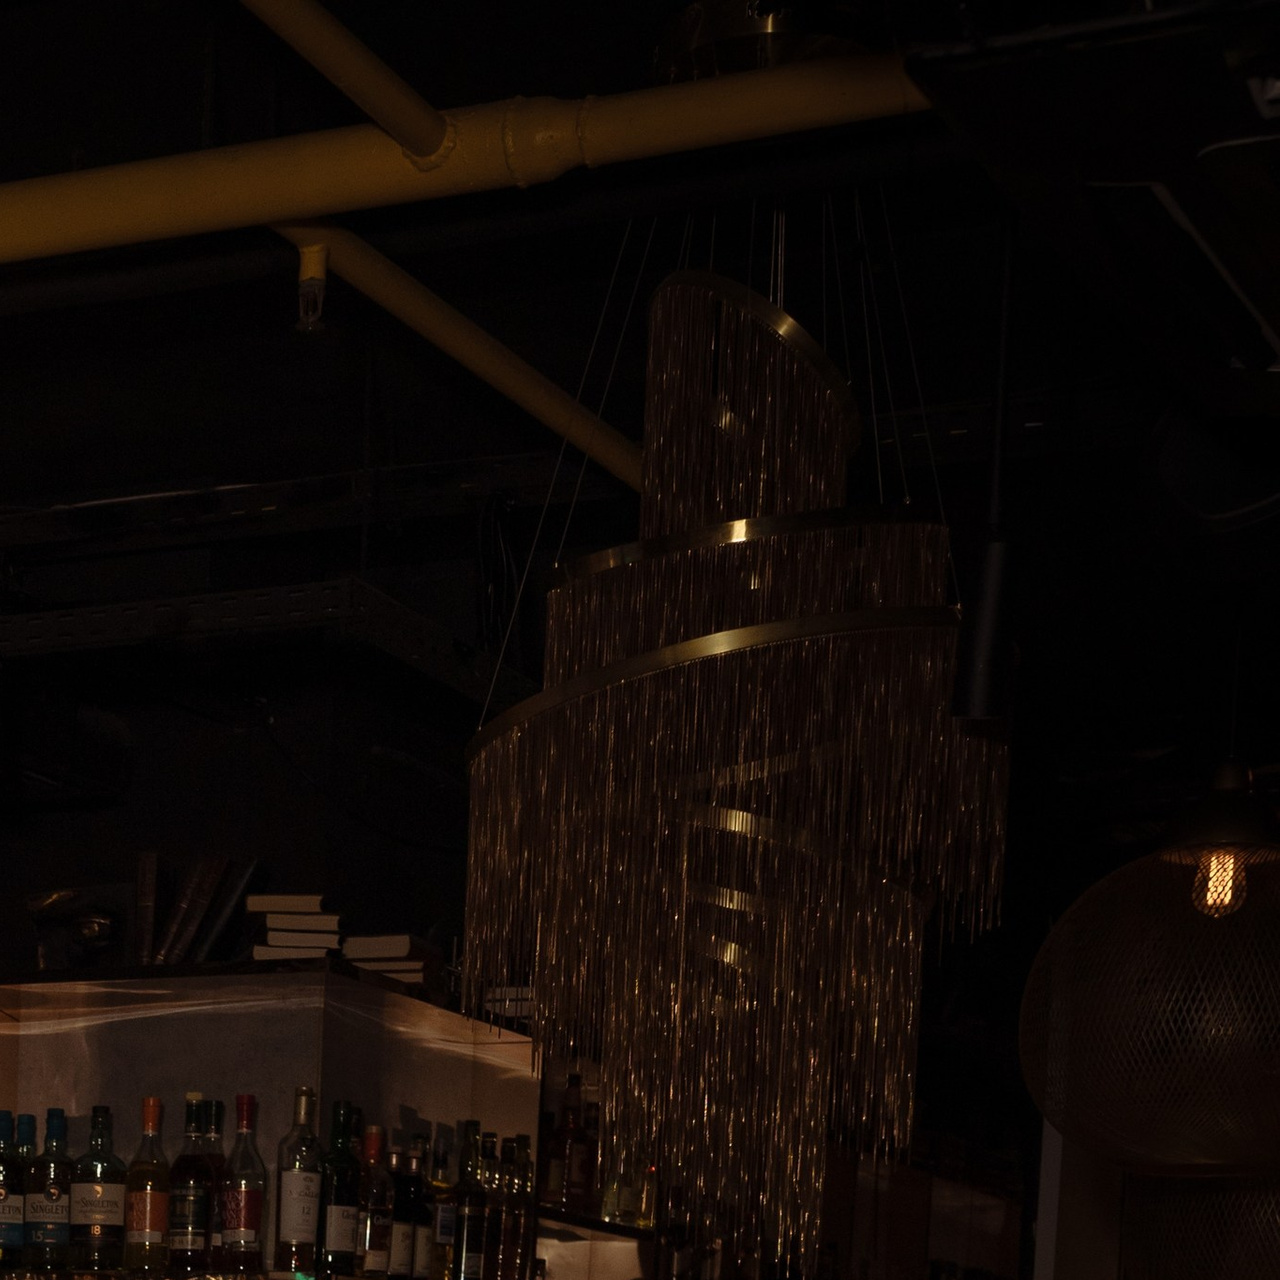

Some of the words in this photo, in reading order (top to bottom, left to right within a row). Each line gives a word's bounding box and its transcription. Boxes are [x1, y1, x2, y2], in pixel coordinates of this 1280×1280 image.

[81, 1197, 120, 1209] SINGLETON
[302, 1206, 311, 1215] 12
[90, 1225, 101, 1236] 18
[32, 1231, 44, 1243] 15
